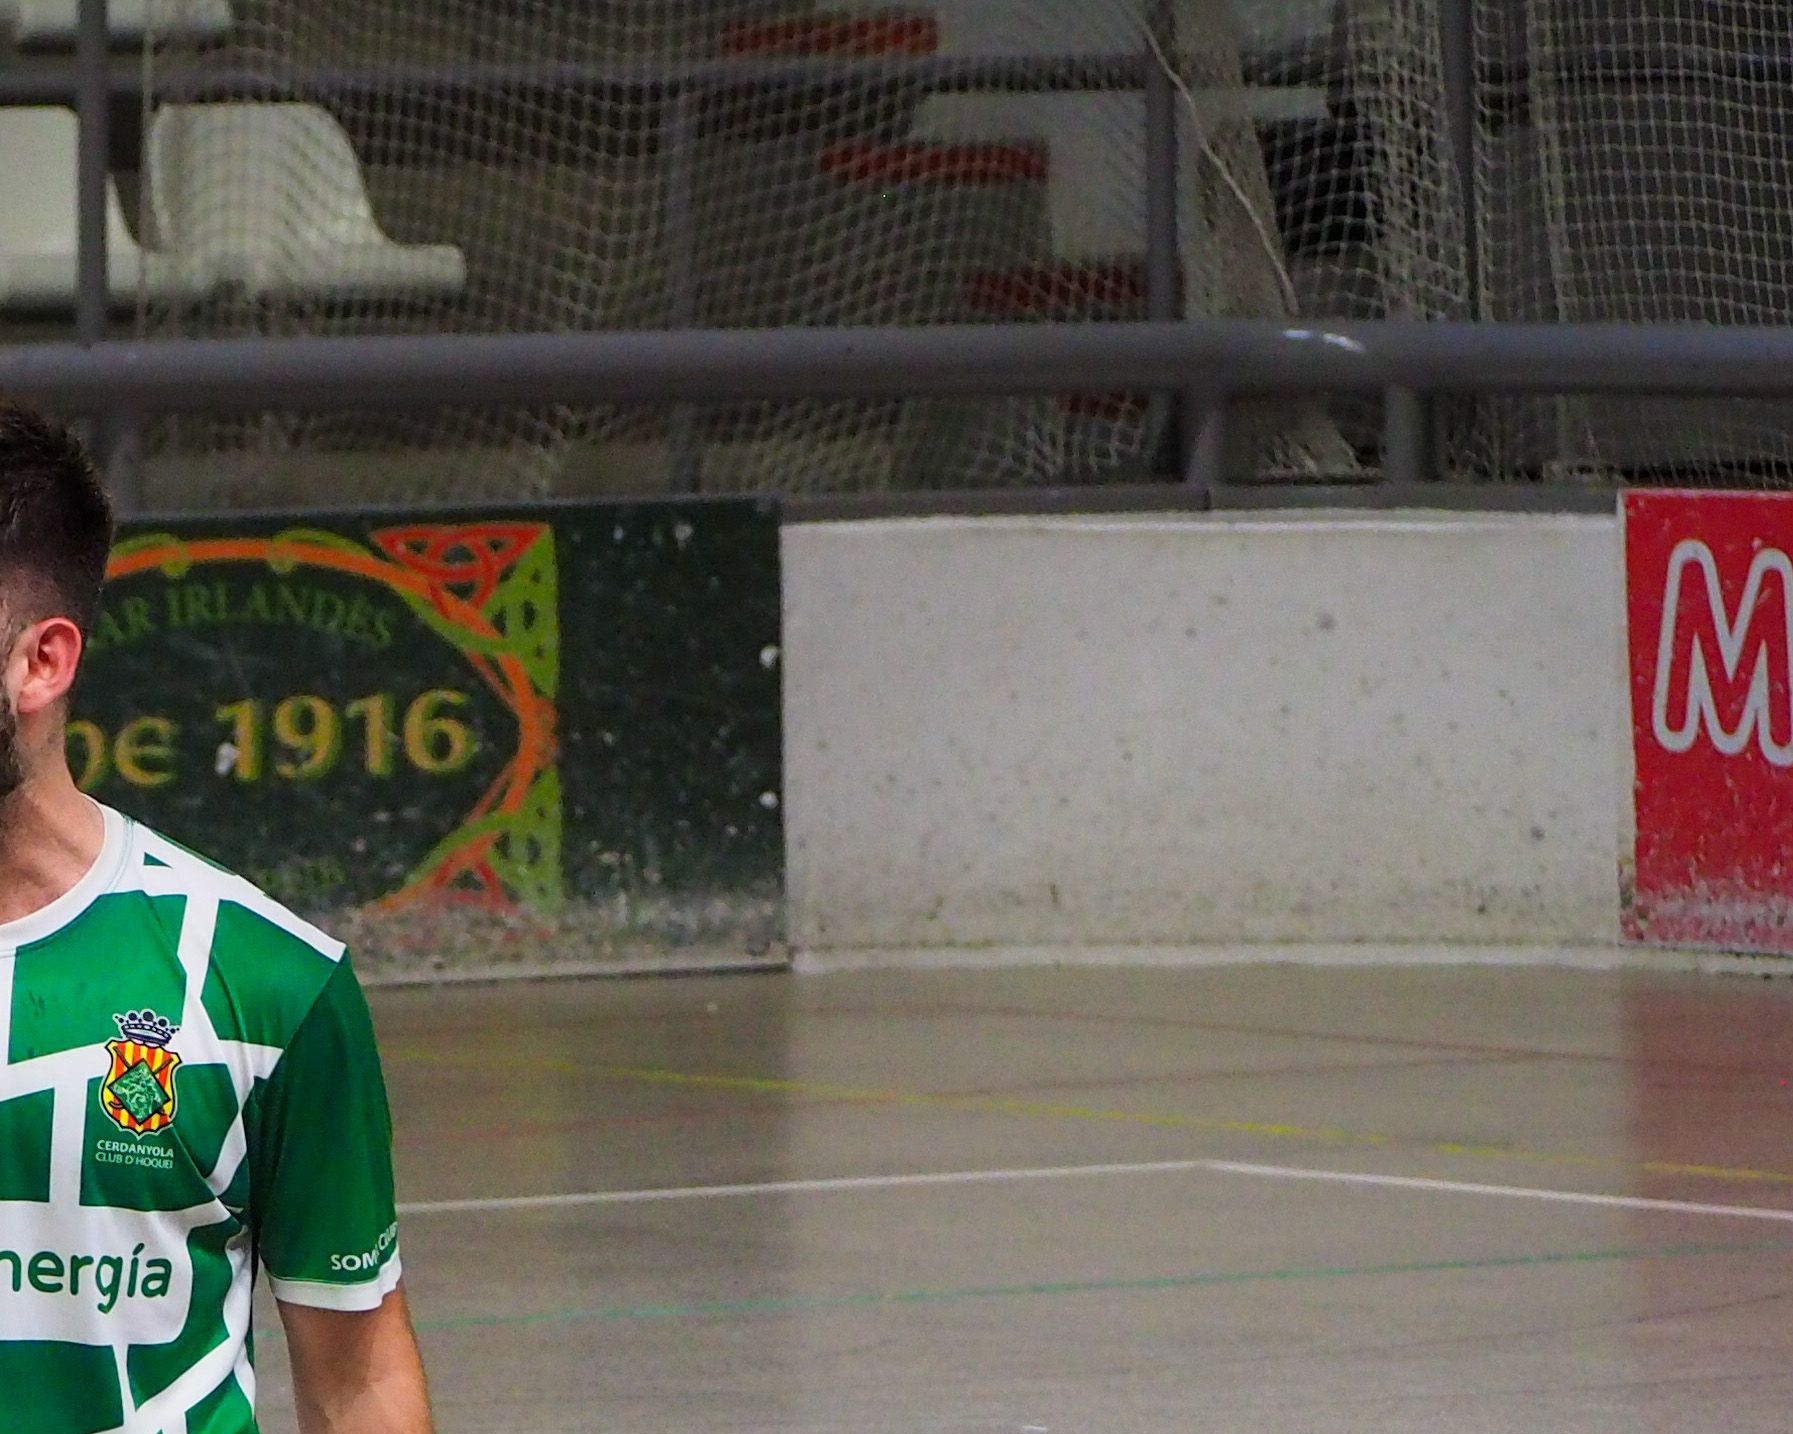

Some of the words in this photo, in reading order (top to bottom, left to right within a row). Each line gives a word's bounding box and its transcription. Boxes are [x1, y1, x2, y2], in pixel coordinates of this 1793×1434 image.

[90, 594, 154, 654] AR
[214, 688, 478, 785] 1916
[95, 1151, 123, 1164] CLUB
[96, 1139, 174, 1158] CERDANYOLA
